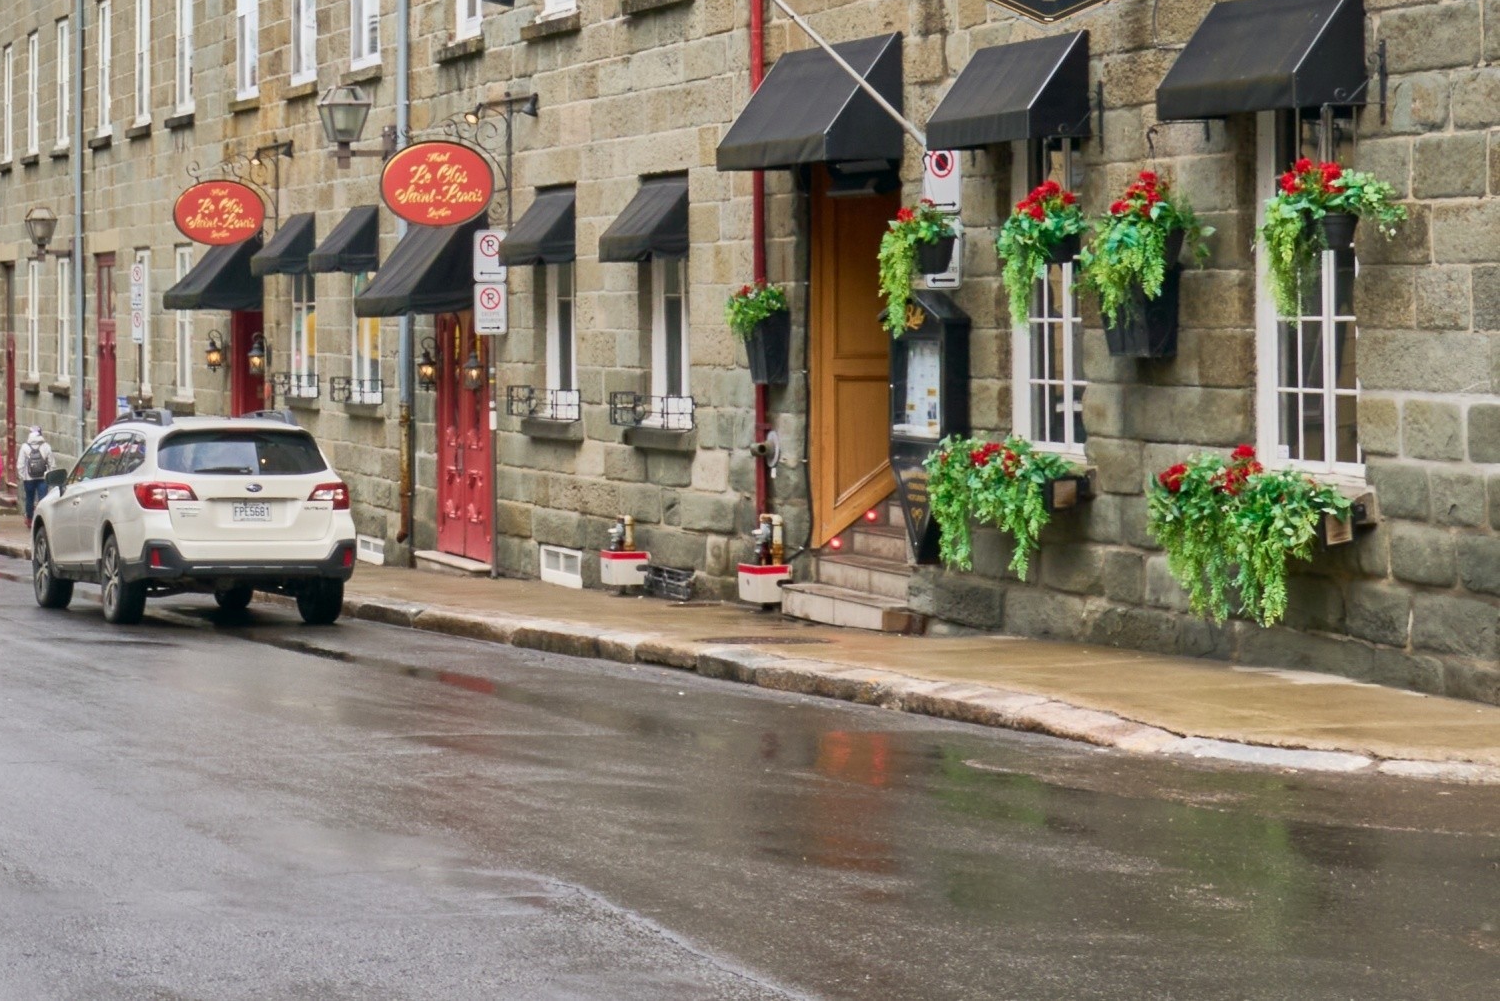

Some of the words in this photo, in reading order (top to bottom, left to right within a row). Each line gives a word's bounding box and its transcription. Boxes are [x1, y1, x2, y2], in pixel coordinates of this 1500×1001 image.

[410, 164, 432, 184] Le
[437, 164, 468, 183] Clos
[395, 183, 483, 204] Saint-Louis
[234, 506, 269, 517] FPE5681
